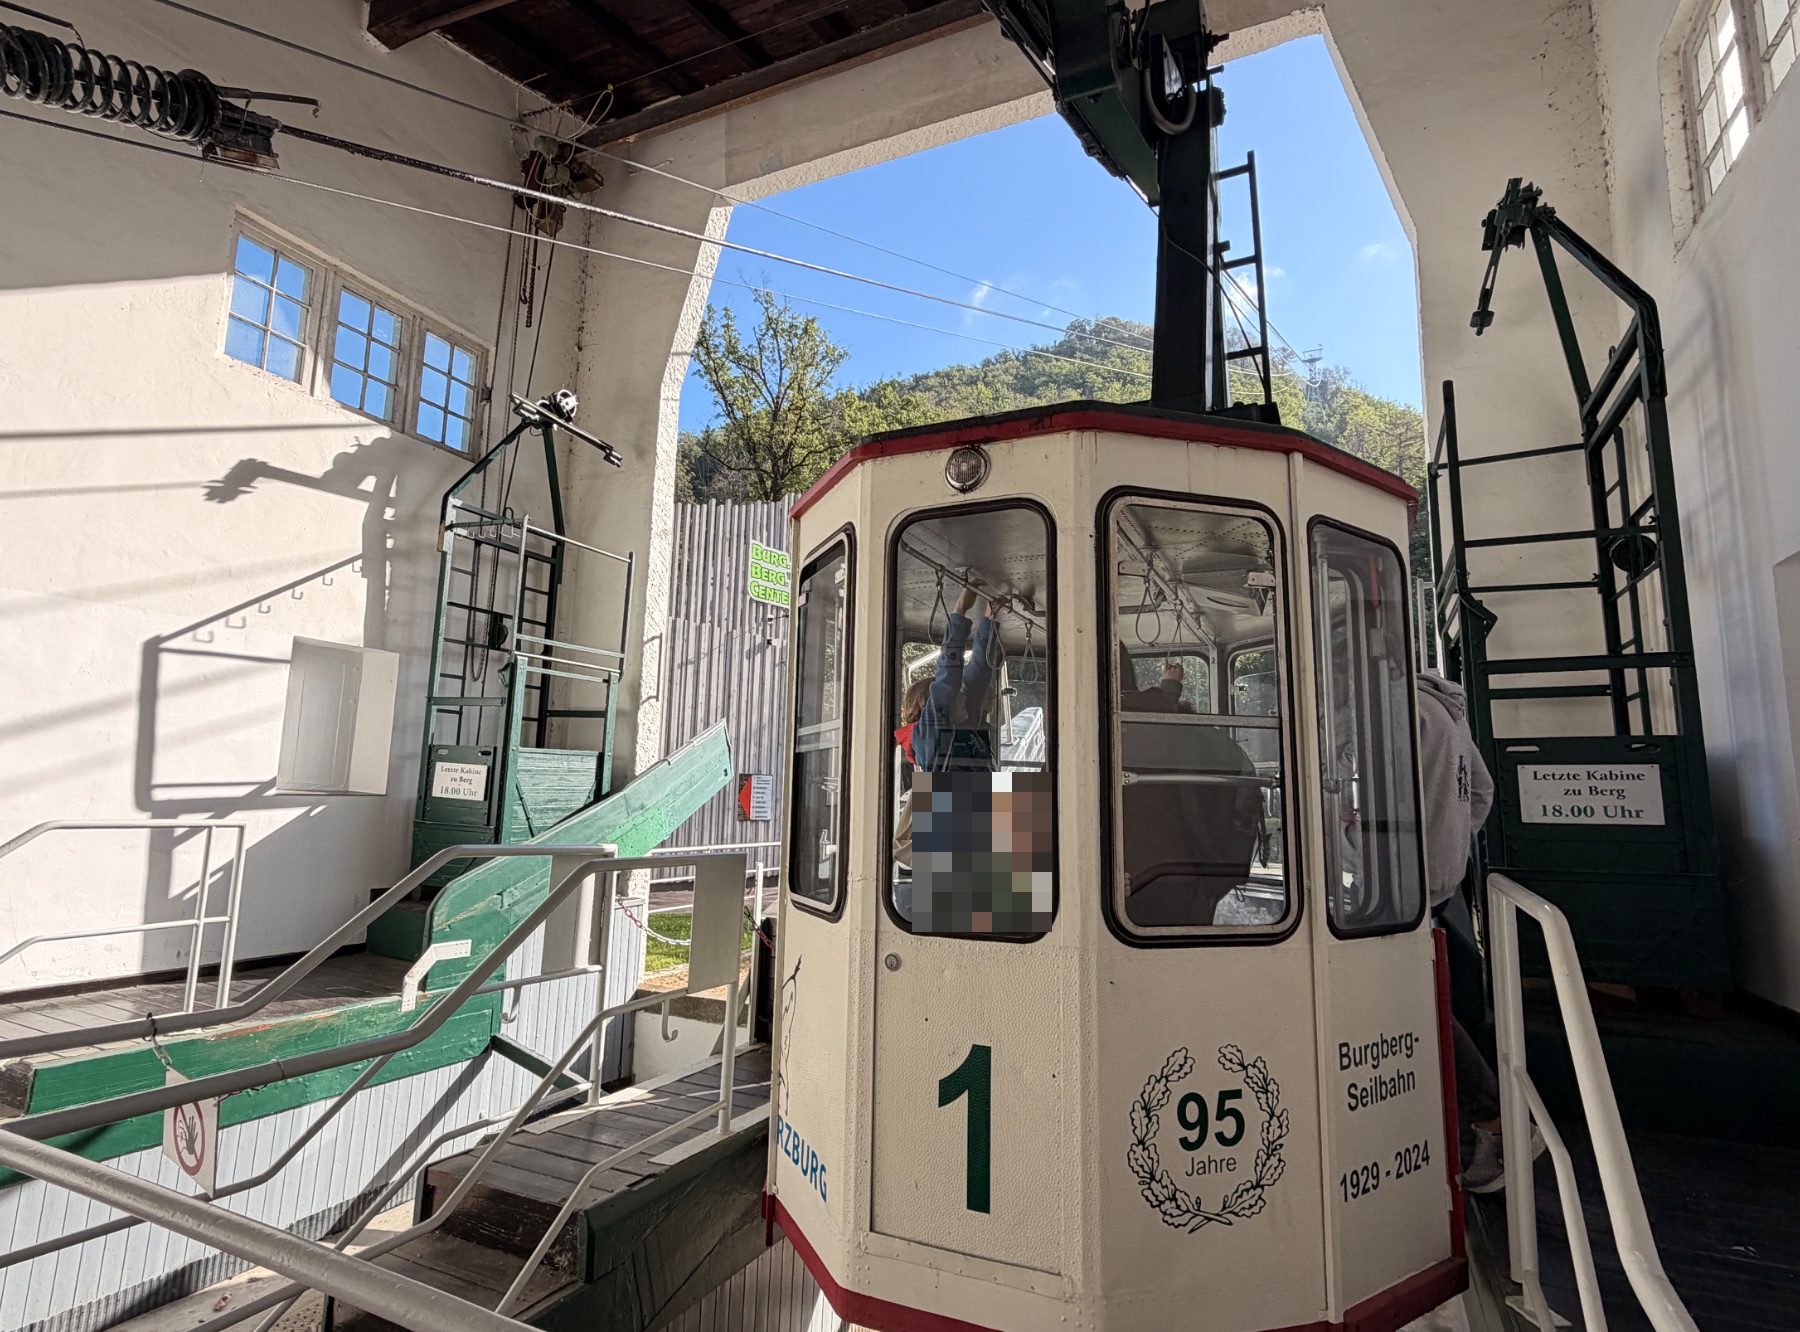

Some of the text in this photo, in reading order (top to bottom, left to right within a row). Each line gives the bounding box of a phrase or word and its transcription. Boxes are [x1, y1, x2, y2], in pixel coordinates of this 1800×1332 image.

[459, 776, 473, 785] Berg
[460, 767, 482, 775] Kabine
[1532, 770, 1646, 781] Letzte Kabine
[440, 786, 478, 797] 18.00 Uhr
[1563, 785, 1626, 800] zu Berg
[1540, 804, 1644, 819] 18.00 Uhr
[1338, 1031, 1420, 1071] Burgberg-
[1347, 1068, 1416, 1112] Seilbahn
[938, 1043, 992, 1215] 1
[1176, 1088, 1246, 1152] 95
[1185, 1154, 1238, 1177] Jahre
[1340, 1161, 1380, 1203] 1929
[1394, 1139, 1430, 1180] 2024
